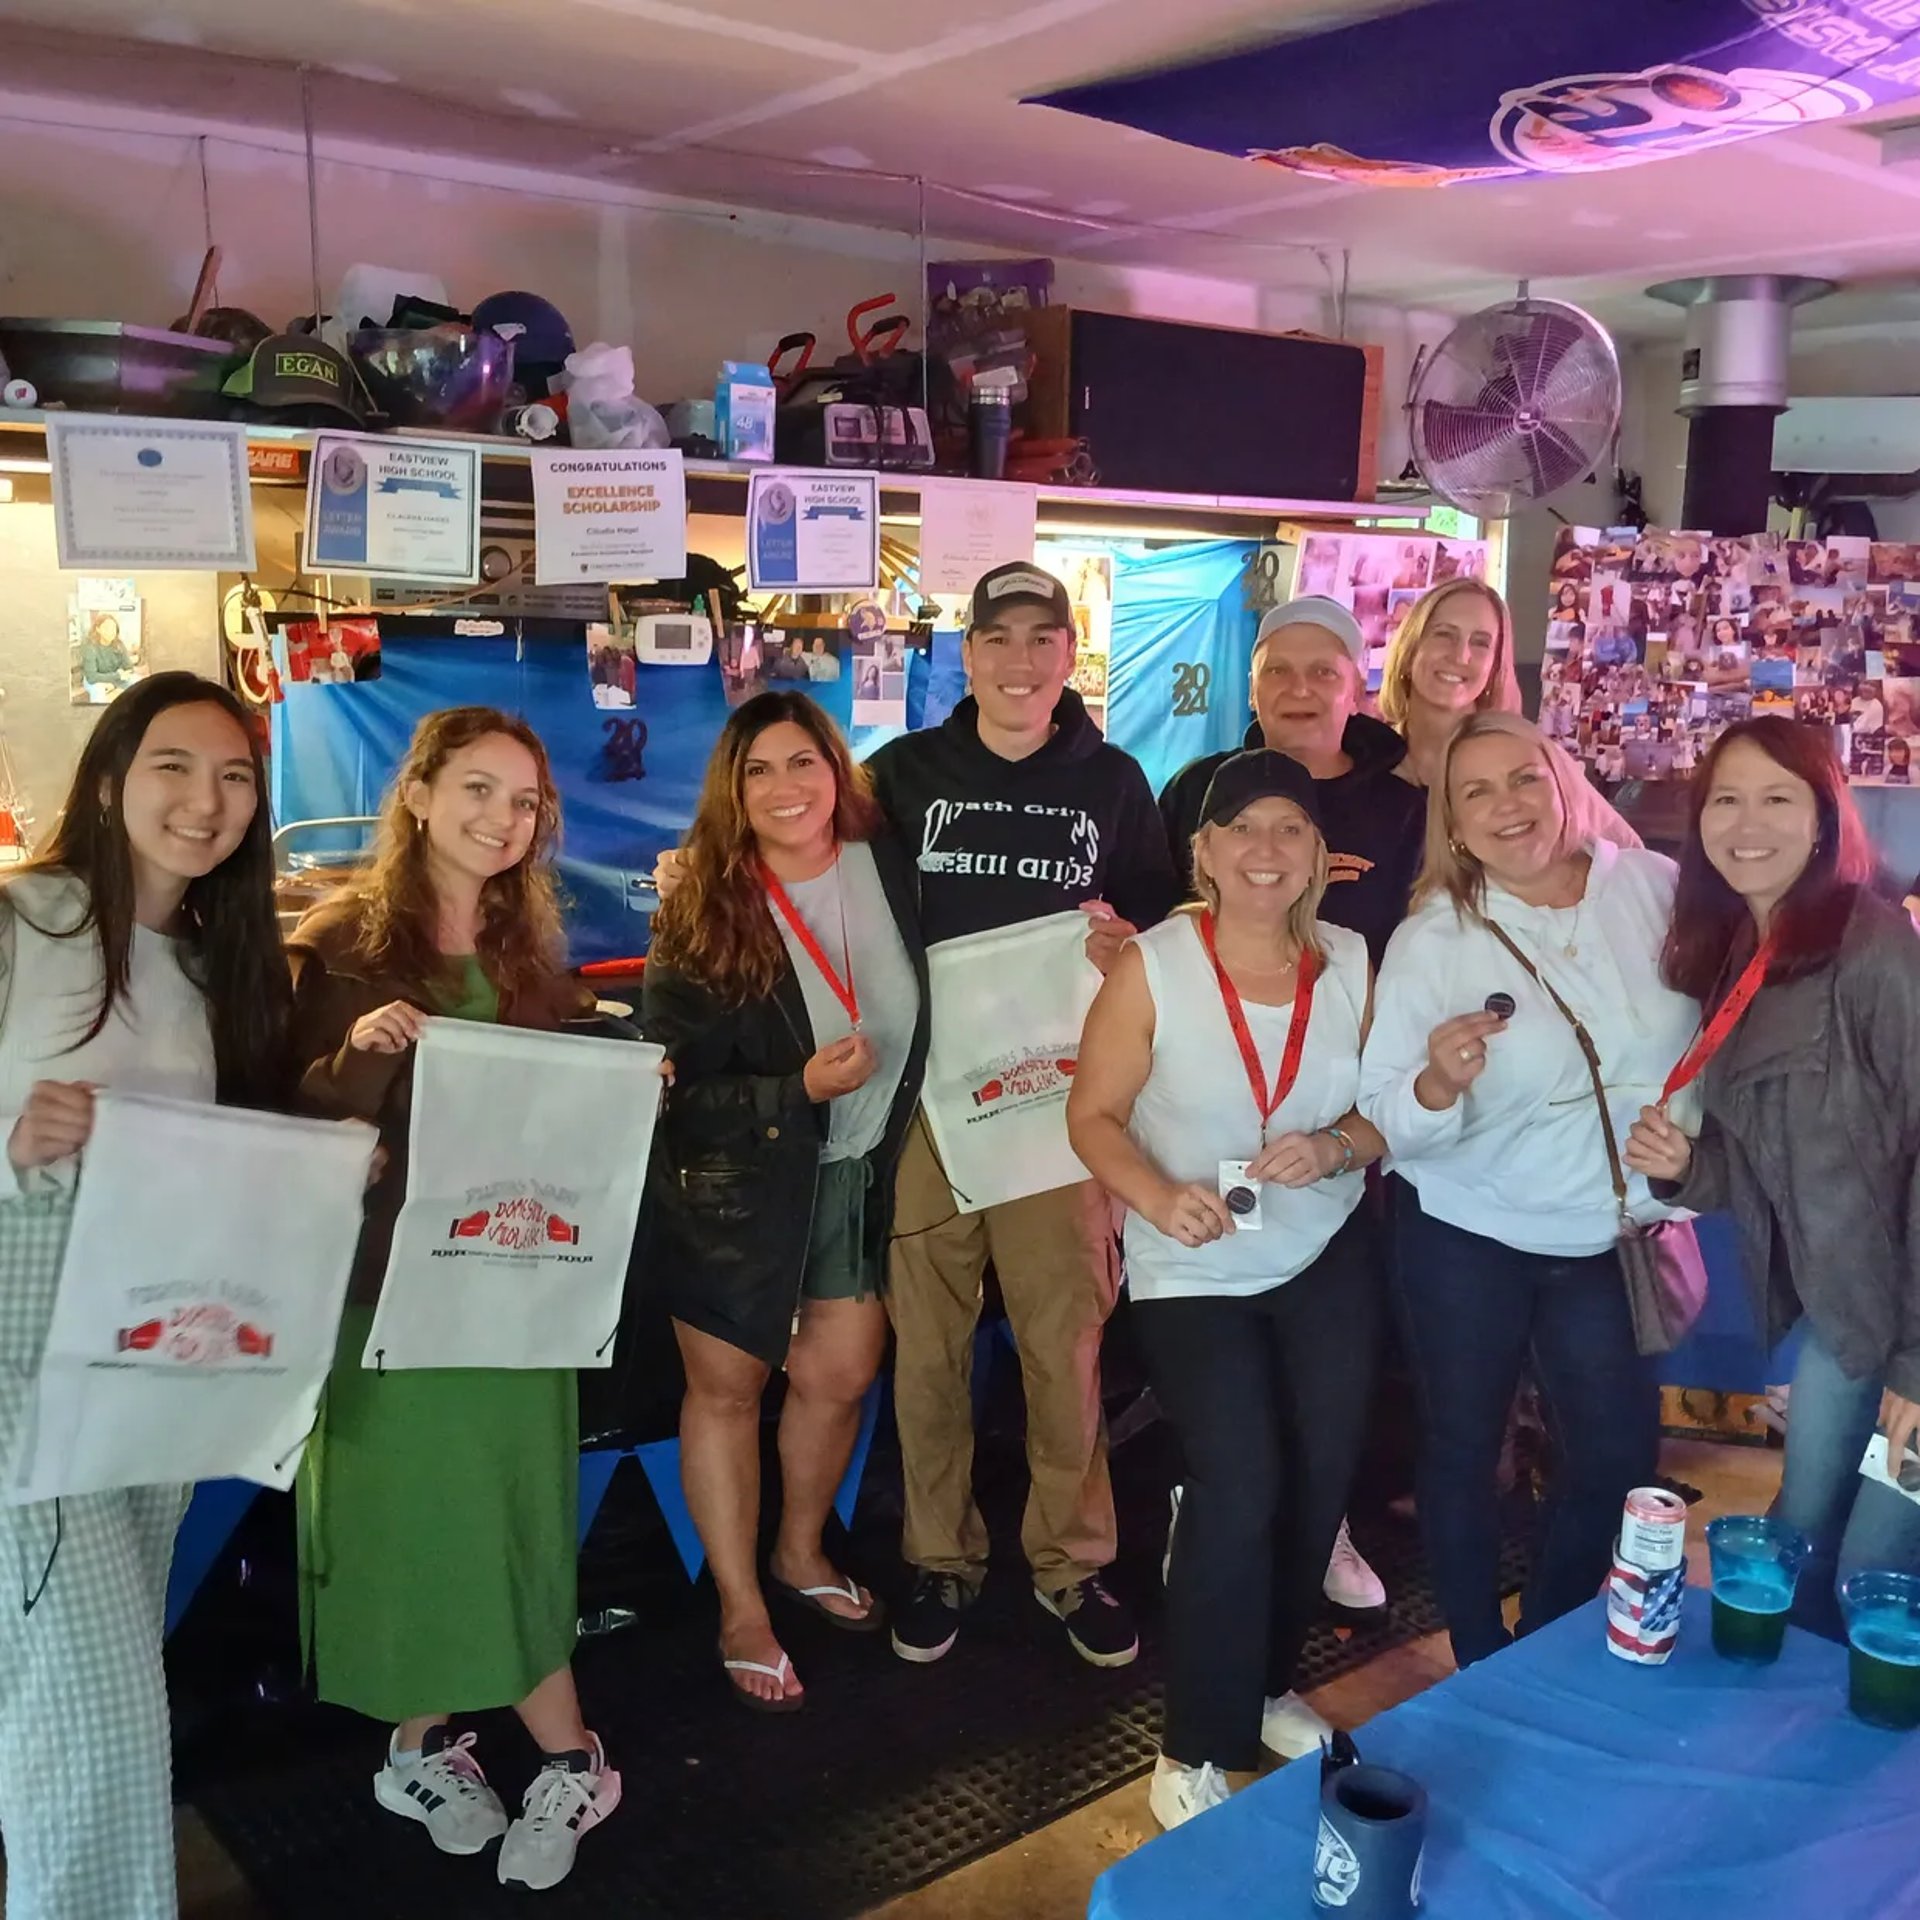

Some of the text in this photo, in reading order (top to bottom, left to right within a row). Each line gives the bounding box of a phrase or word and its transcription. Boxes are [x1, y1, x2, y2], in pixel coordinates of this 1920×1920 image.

[283, 356, 335, 379] EGAN
[389, 452, 449, 466] EASTVIEW
[379, 465, 458, 480] HIGH SCHOOL
[550, 461, 667, 473] CONGRATULATIONS
[567, 485, 655, 498] EXCELLENCE
[811, 484, 856, 493] EASTVIEW
[563, 500, 661, 514] SCHOLARSHIP
[827, 495, 862, 505] SCHOOL
[1172, 662, 1210, 691] 20
[1172, 688, 1208, 716] 24
